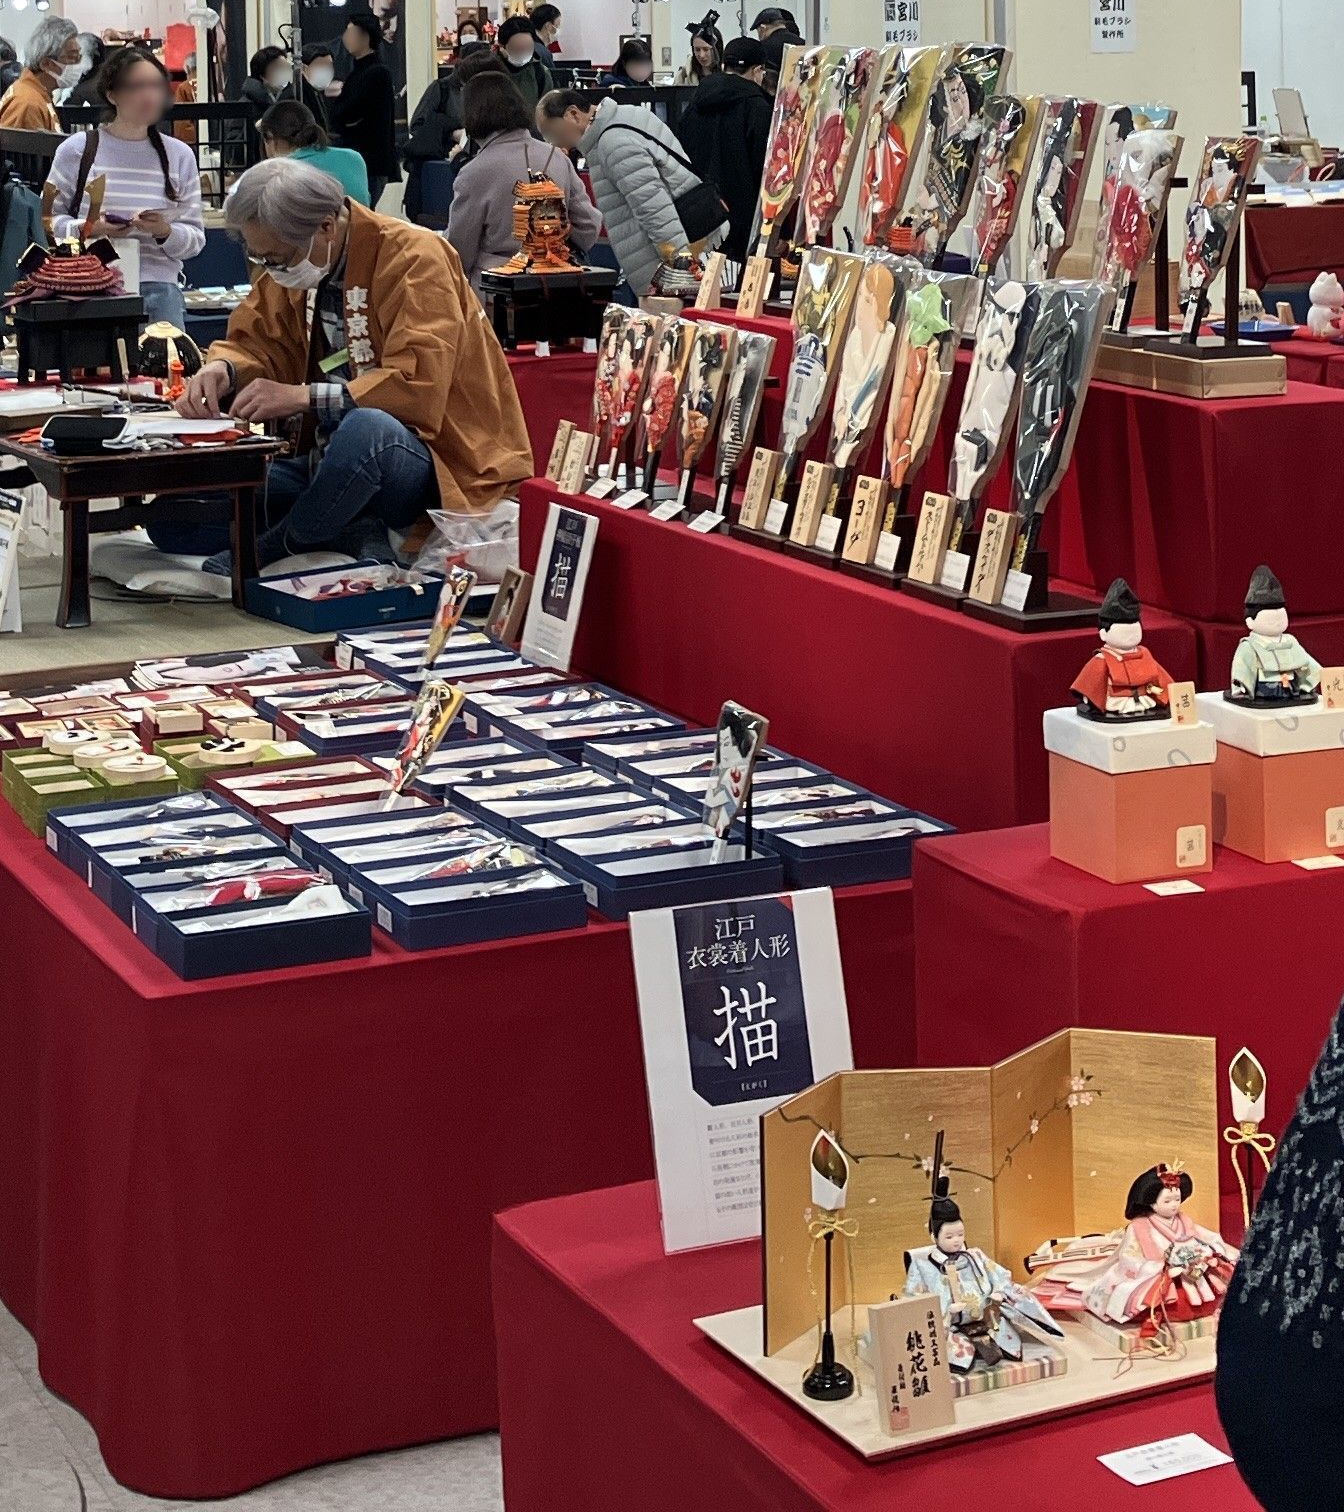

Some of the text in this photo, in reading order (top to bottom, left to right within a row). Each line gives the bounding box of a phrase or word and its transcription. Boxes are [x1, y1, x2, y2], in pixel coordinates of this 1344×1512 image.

[897, 1, 918, 21] 宮川
[715, 914, 756, 939] 江戸
[687, 933, 790, 970] 衣裳着人形
[713, 980, 779, 1071] 描
